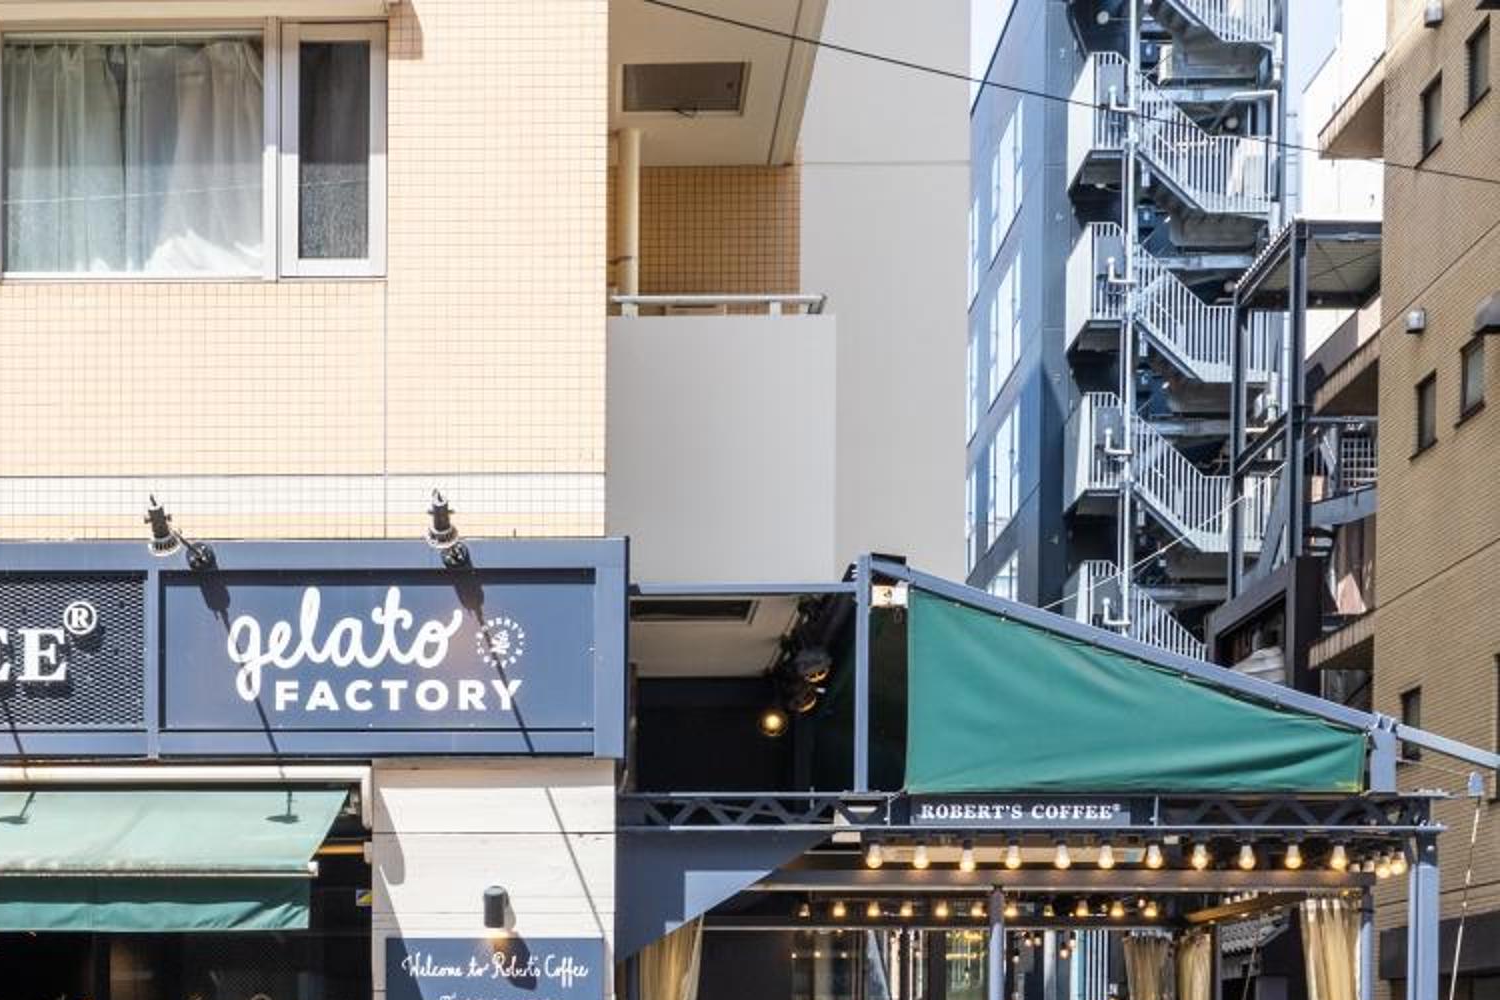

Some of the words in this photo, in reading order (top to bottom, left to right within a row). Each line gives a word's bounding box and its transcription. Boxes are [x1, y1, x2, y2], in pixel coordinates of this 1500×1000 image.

[227, 586, 463, 701] gelato
[275, 680, 523, 711] FACTORY
[920, 803, 1023, 820] ROBERT'S
[401, 951, 463, 978] Welcome
[467, 955, 489, 978] to
[491, 951, 541, 979] Robert's
[544, 954, 589, 989] Coffee
